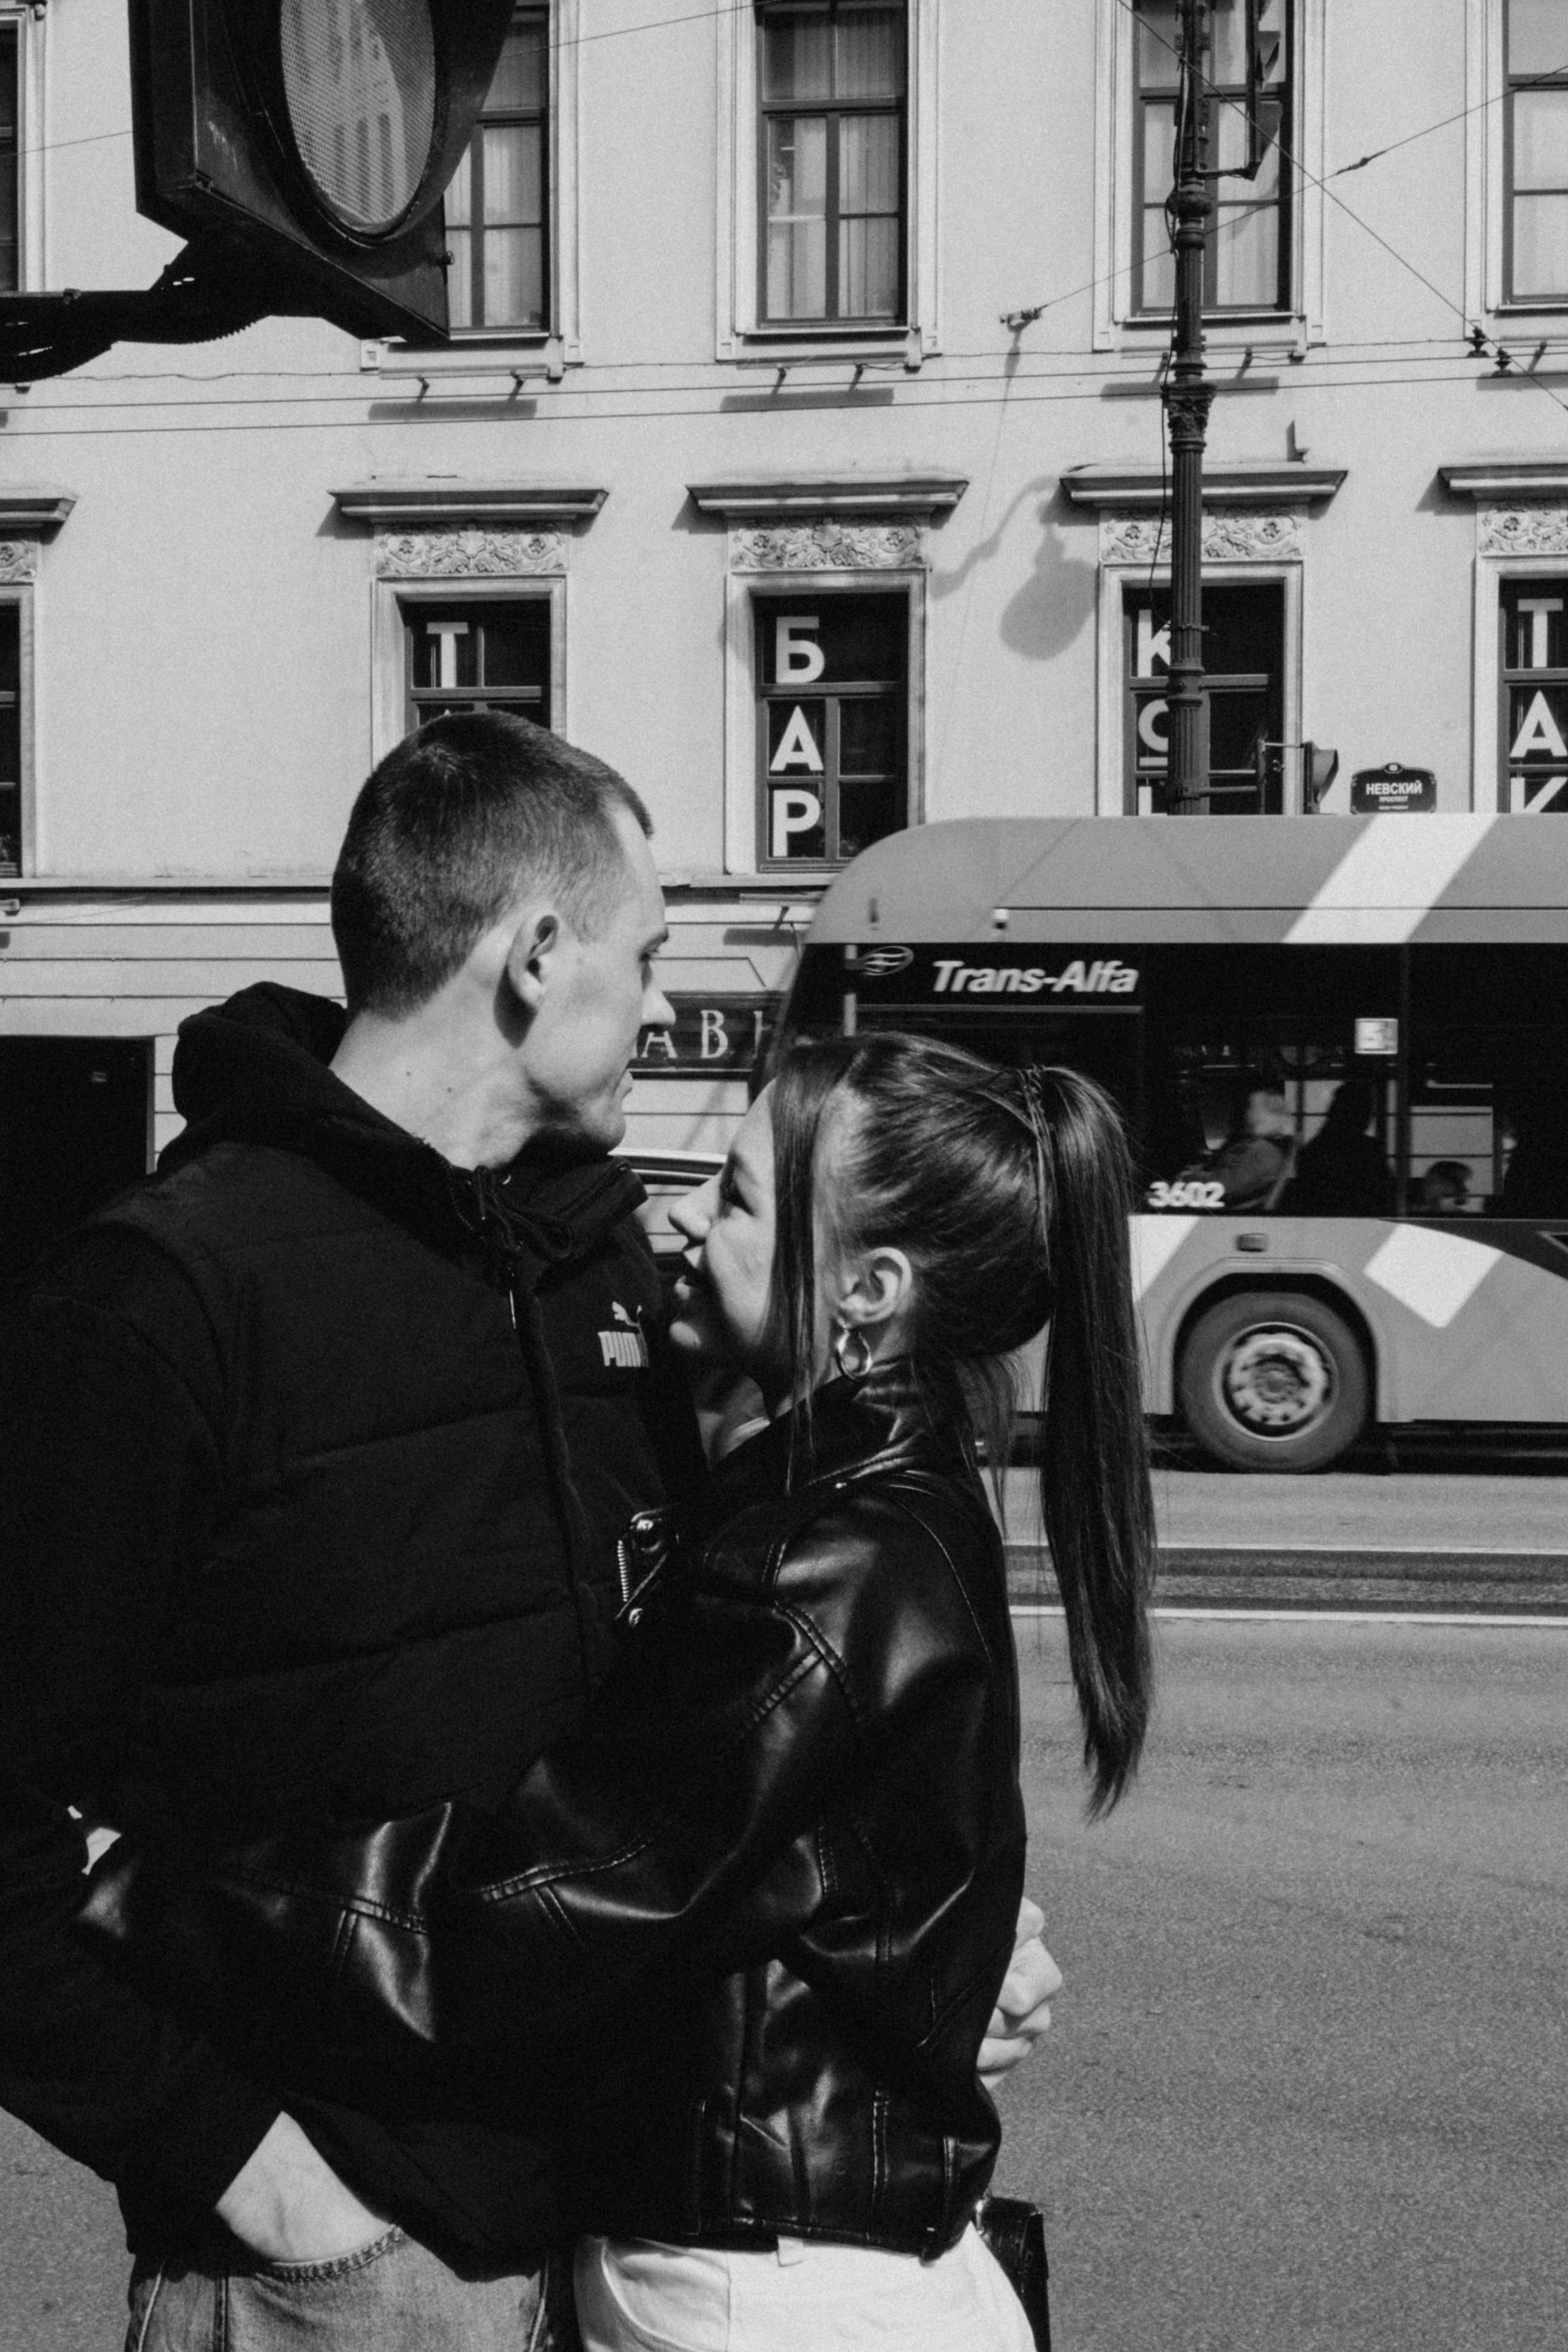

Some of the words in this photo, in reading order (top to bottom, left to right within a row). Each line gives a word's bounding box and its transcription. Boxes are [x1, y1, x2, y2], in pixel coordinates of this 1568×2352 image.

[770, 616, 825, 857] БАР
[1366, 780, 1422, 795] НЕВСКИЙ
[932, 960, 1139, 993] Trans-Alfa
[1148, 1182, 1225, 1207] 3602
